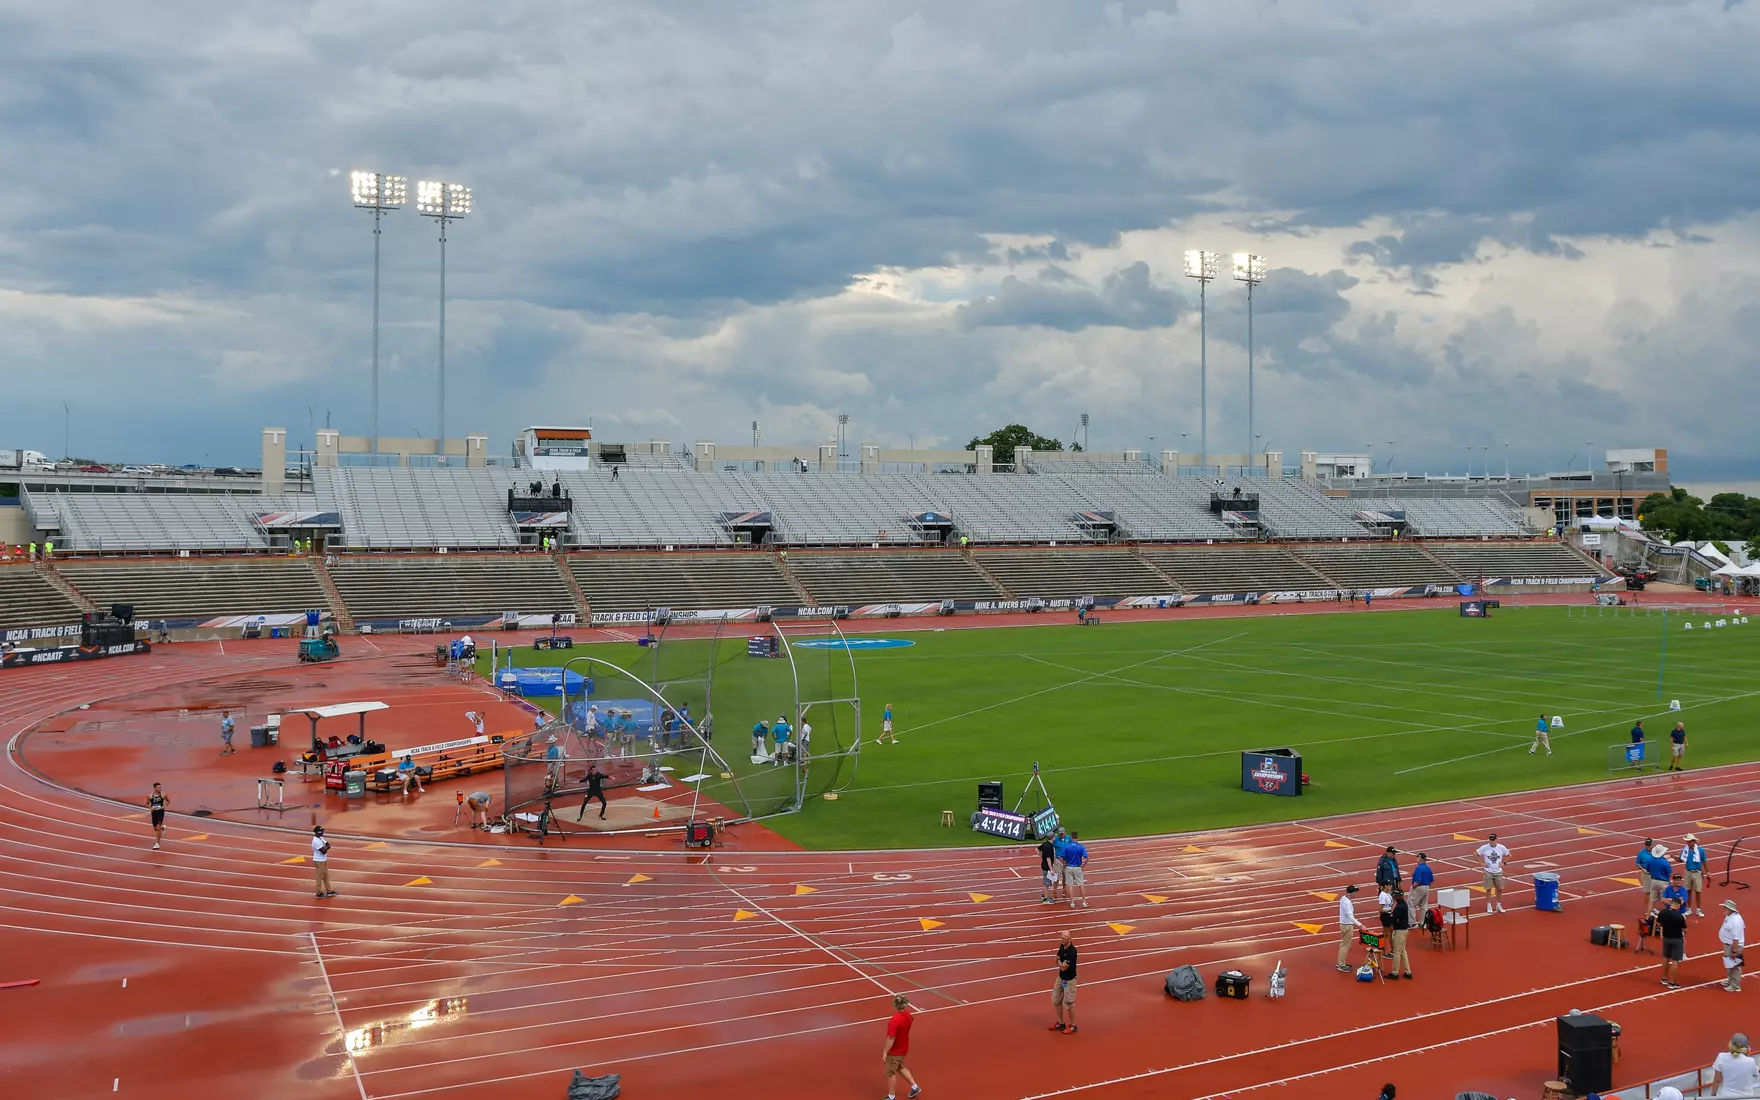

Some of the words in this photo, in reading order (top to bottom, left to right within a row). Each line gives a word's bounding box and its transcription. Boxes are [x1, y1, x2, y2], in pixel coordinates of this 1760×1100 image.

[974, 602, 990, 610] MIKE
[998, 600, 1018, 608] MYERS
[798, 606, 832, 616] NCAA.COM
[592, 614, 614, 622] TRACK
[622, 612, 640, 620] FIELD
[6, 629, 28, 640] NCAA
[31, 626, 56, 639] TRACK
[108, 644, 135, 655] NCAA.COM
[32, 651, 64, 662] #NCAATF
[982, 816, 1020, 836] 4:14:14
[1038, 814, 1056, 835] 4:14:14
